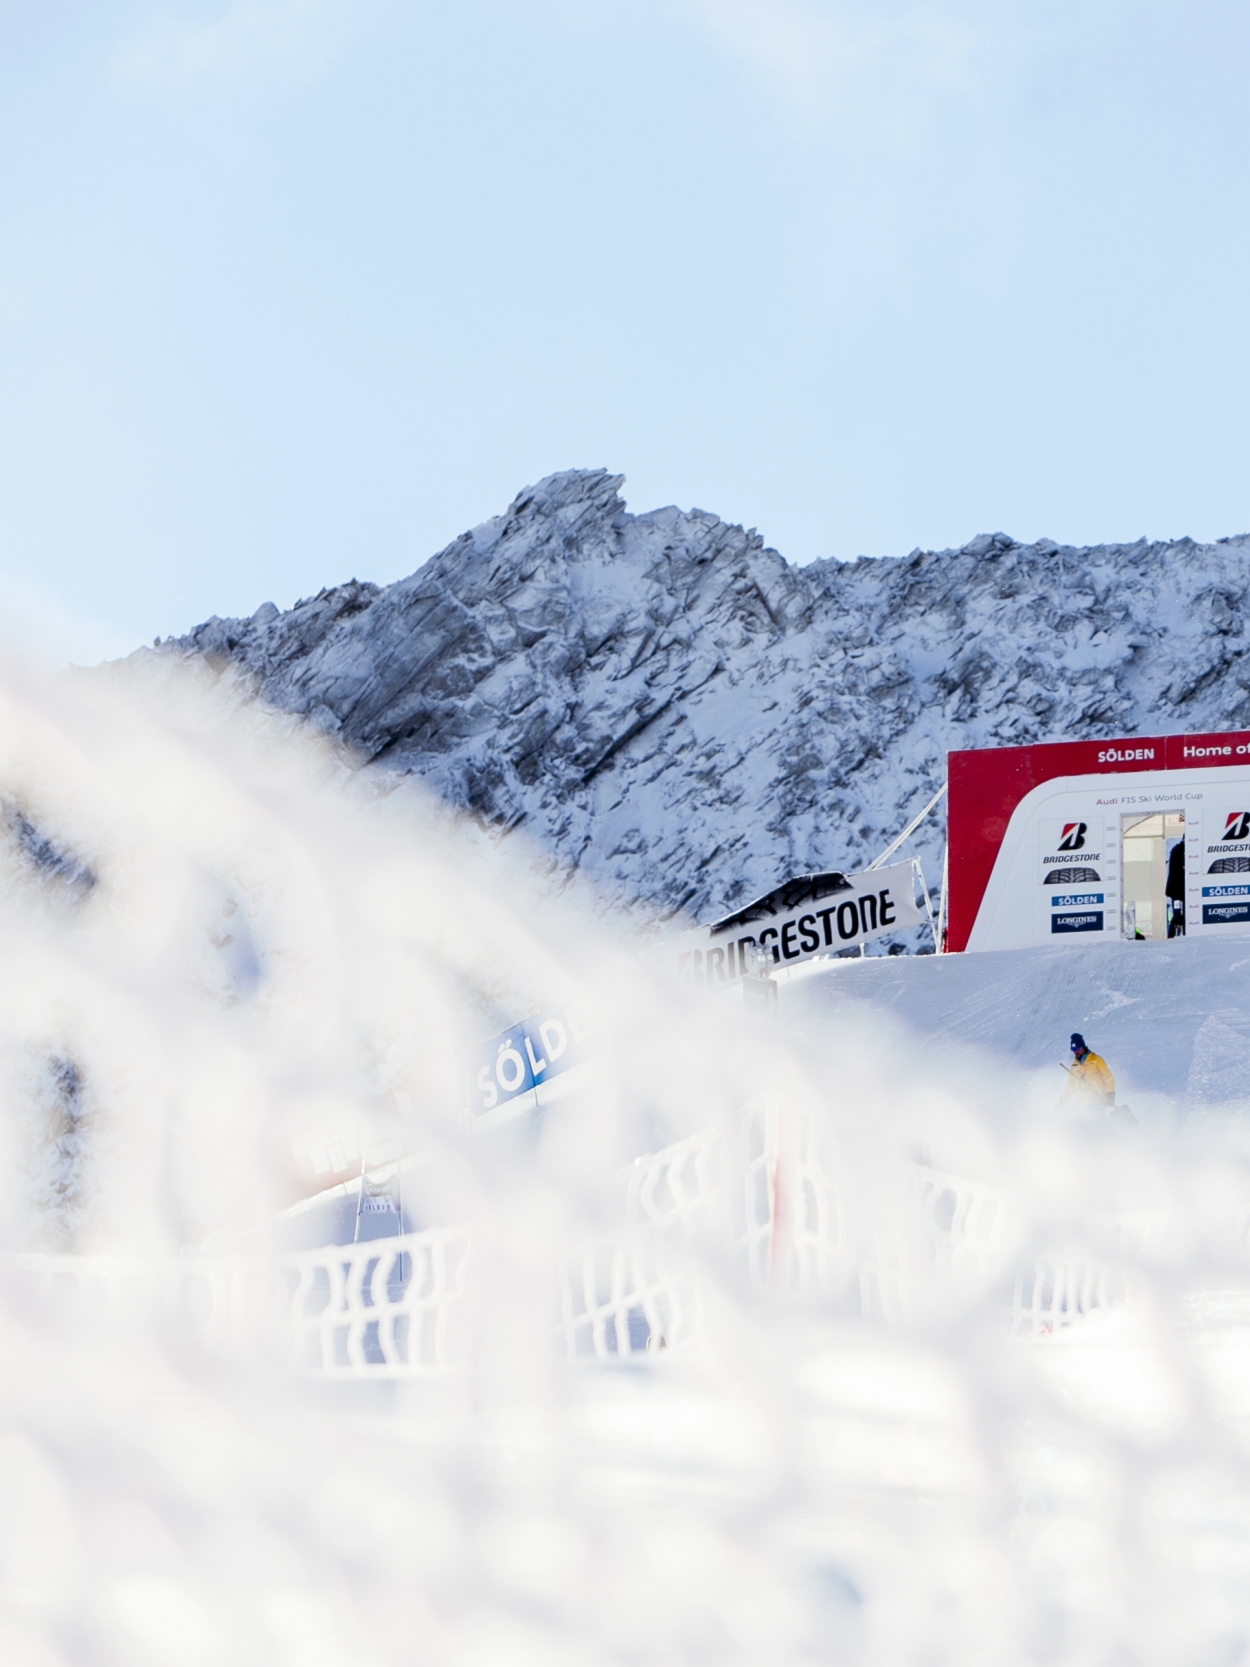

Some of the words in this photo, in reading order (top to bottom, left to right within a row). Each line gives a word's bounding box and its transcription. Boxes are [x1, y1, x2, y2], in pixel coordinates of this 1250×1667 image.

[1098, 748, 1155, 763] SÖLDEN
[1183, 745, 1232, 758] Home
[1096, 797, 1118, 806] Audi
[1121, 796, 1136, 804] FIS
[1139, 795, 1152, 803] Ski
[1155, 792, 1183, 802] World
[1185, 792, 1204, 802] Cup
[1043, 853, 1102, 864] BRIDGESTONE
[1209, 886, 1248, 896] SÖLDEN
[1058, 895, 1098, 906] SÖLDEN
[1208, 906, 1248, 915] LONGINES
[1057, 915, 1098, 925] LONGINES
